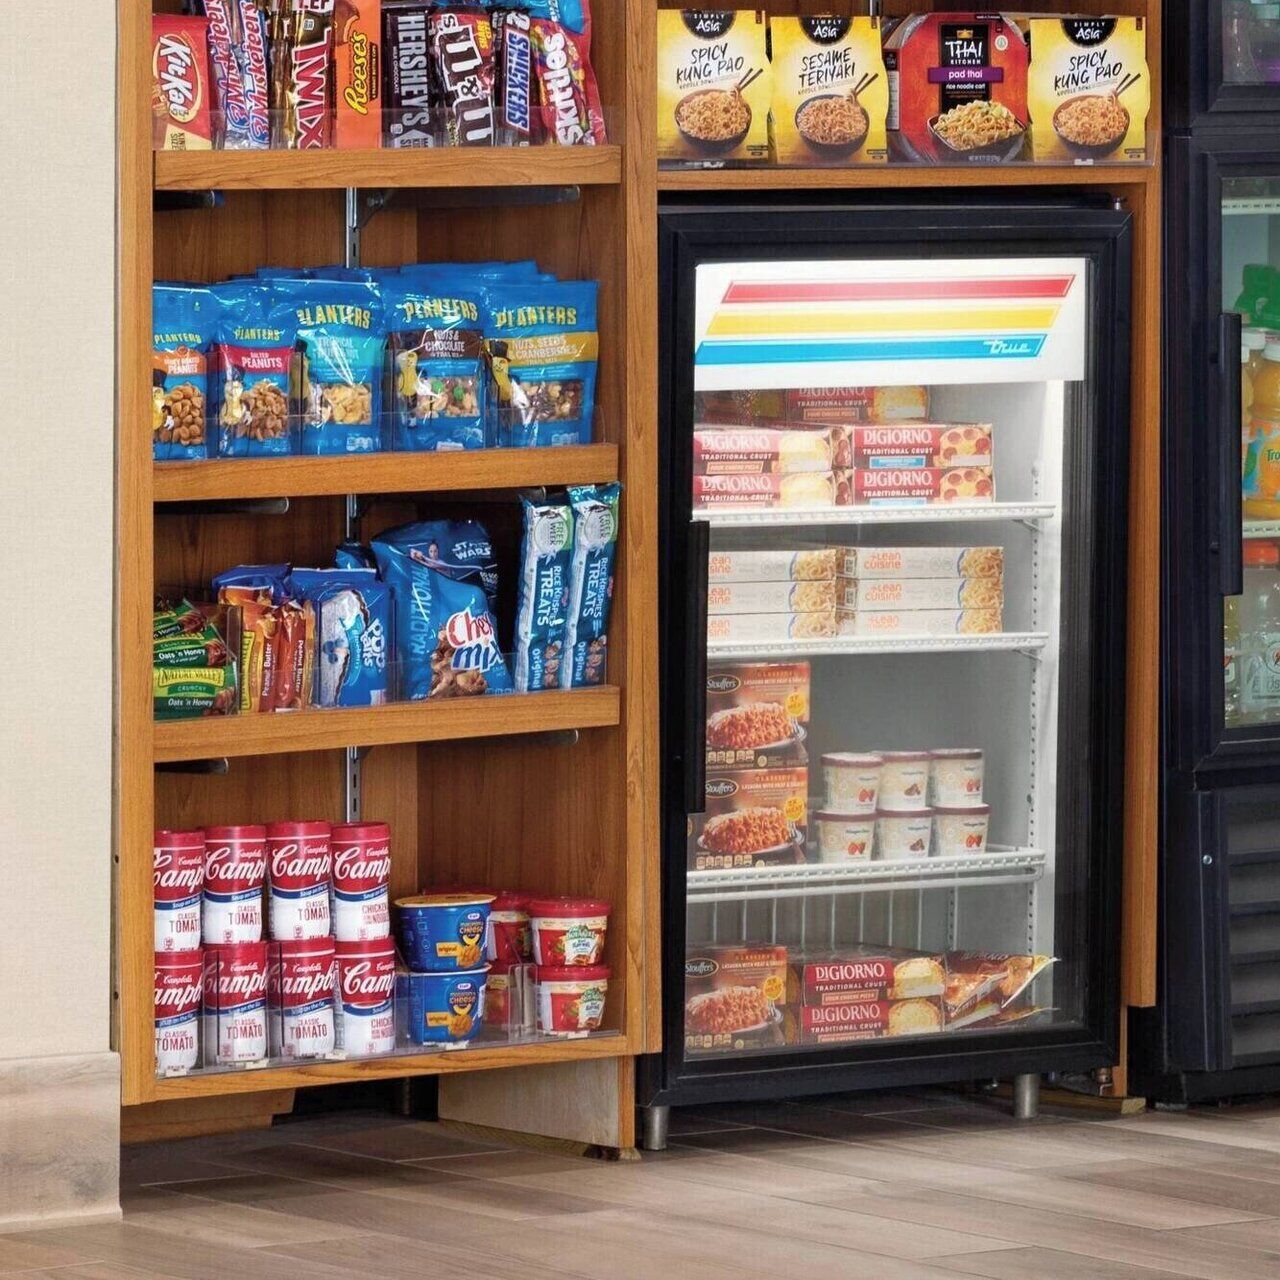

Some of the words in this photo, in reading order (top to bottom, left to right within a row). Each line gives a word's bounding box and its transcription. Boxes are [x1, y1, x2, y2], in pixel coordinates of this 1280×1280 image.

[696, 20, 721, 33] Asia
[814, 26, 838, 38] Asia
[1076, 28, 1100, 40] Asia
[240, 0, 268, 119] Musketeers
[691, 43, 728, 64] SPICY
[802, 47, 852, 72] SESAME
[945, 40, 983, 58] THAI
[1069, 49, 1107, 71] SPICY
[344, 32, 369, 115] Reese's
[397, 15, 430, 127] HERSHEY'S
[508, 32, 529, 129] SNICKERS
[676, 62, 712, 83] KUNG
[718, 57, 744, 71] PAO
[798, 63, 855, 87] TERIYAKI
[949, 71, 966, 80] pad
[968, 70, 983, 79] thai
[1054, 70, 1089, 91] KUNG
[1095, 63, 1122, 78] PAO
[293, 27, 332, 149] TWIX
[543, 33, 583, 145] Skittles
[296, 304, 371, 329] PLANTERS
[495, 306, 577, 329] PLANTERS
[155, 334, 201, 344] PLANTERS
[425, 340, 465, 352] CHOCOLATE
[983, 339, 1032, 355] True
[242, 357, 282, 369] PEANUTS
[549, 521, 557, 547] WEEK
[556, 520, 565, 546] FREE
[455, 547, 491, 560] WARS
[553, 565, 562, 587] RICE
[599, 557, 608, 577] RICE
[537, 567, 554, 626] TREATS
[582, 561, 600, 618] TREATS
[593, 577, 607, 618] KRISPIES
[447, 611, 493, 647] Chex
[263, 642, 273, 668] Butter
[574, 641, 586, 682] Original
[532, 648, 543, 689] Original
[168, 698, 183, 706] Oats
[815, 983, 862, 991] TRADITIONAL
[864, 981, 887, 989] CRUST
[165, 1030, 187, 1038] CLASSIC
[226, 1024, 263, 1039] TOMATO
[290, 1024, 328, 1038] TOMATO
[811, 1025, 857, 1033] TRADITIONAL
[860, 1022, 882, 1030] CRUST
[156, 1037, 194, 1051] TOMATO
